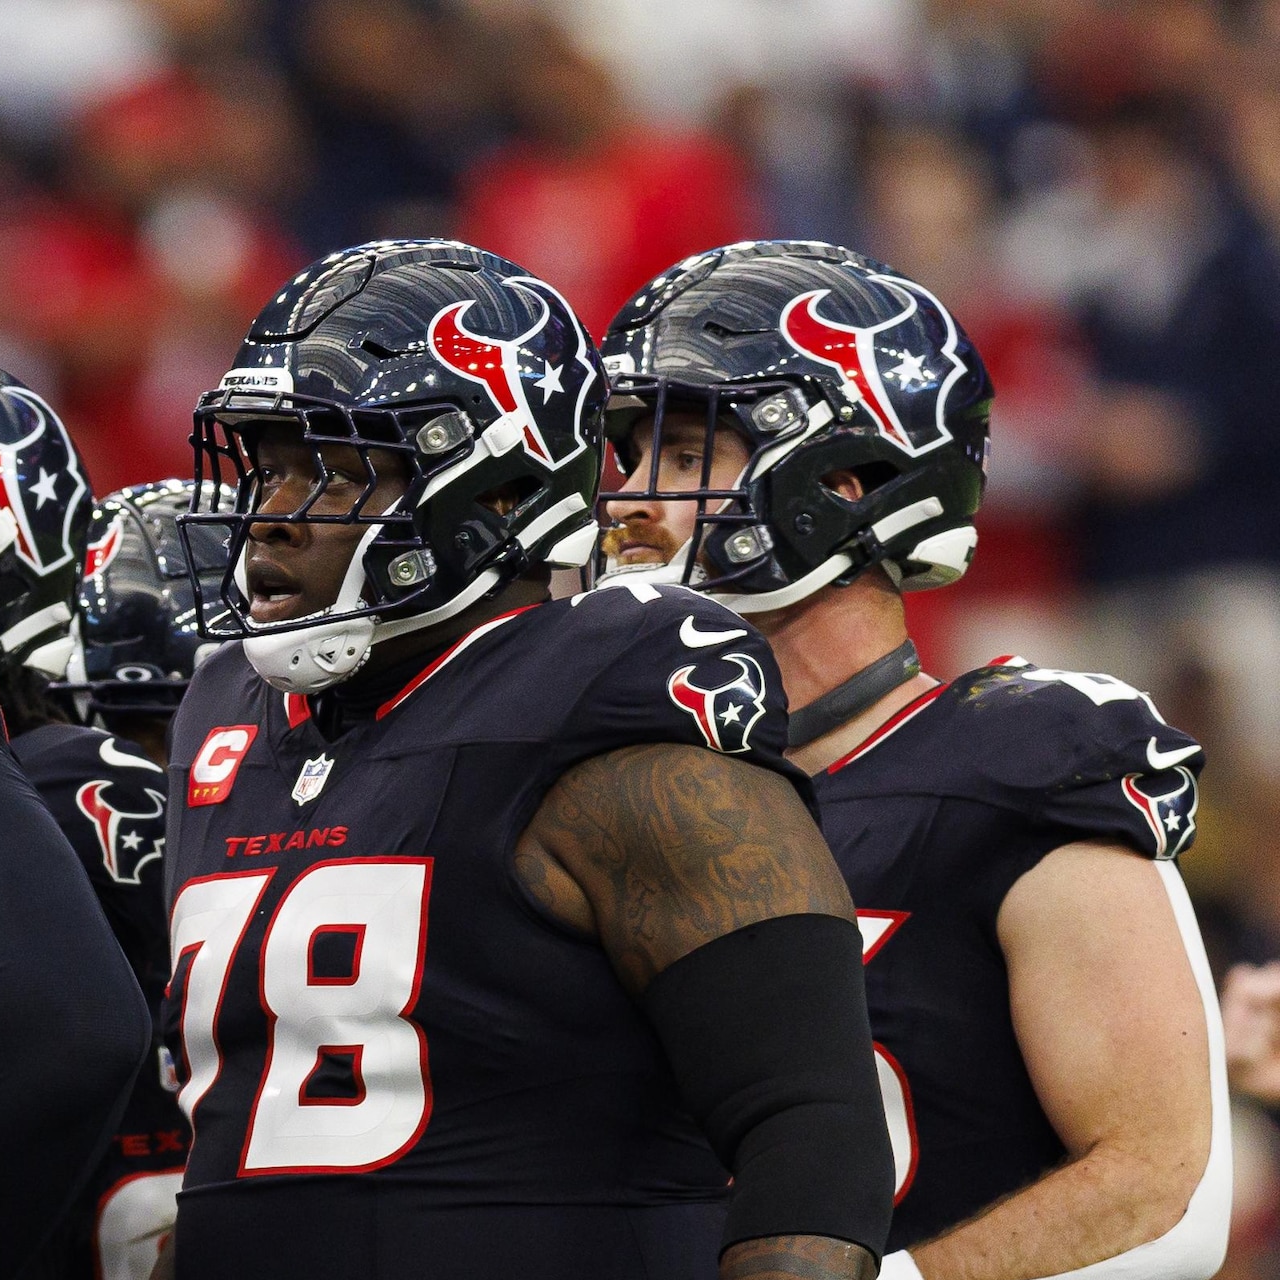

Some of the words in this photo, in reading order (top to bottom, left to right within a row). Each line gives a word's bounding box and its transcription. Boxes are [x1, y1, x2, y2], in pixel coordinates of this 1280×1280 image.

[223, 376, 279, 386] TEXANS
[193, 729, 249, 784] C
[225, 825, 349, 858] TEXANS
[164, 855, 435, 1179] 78
